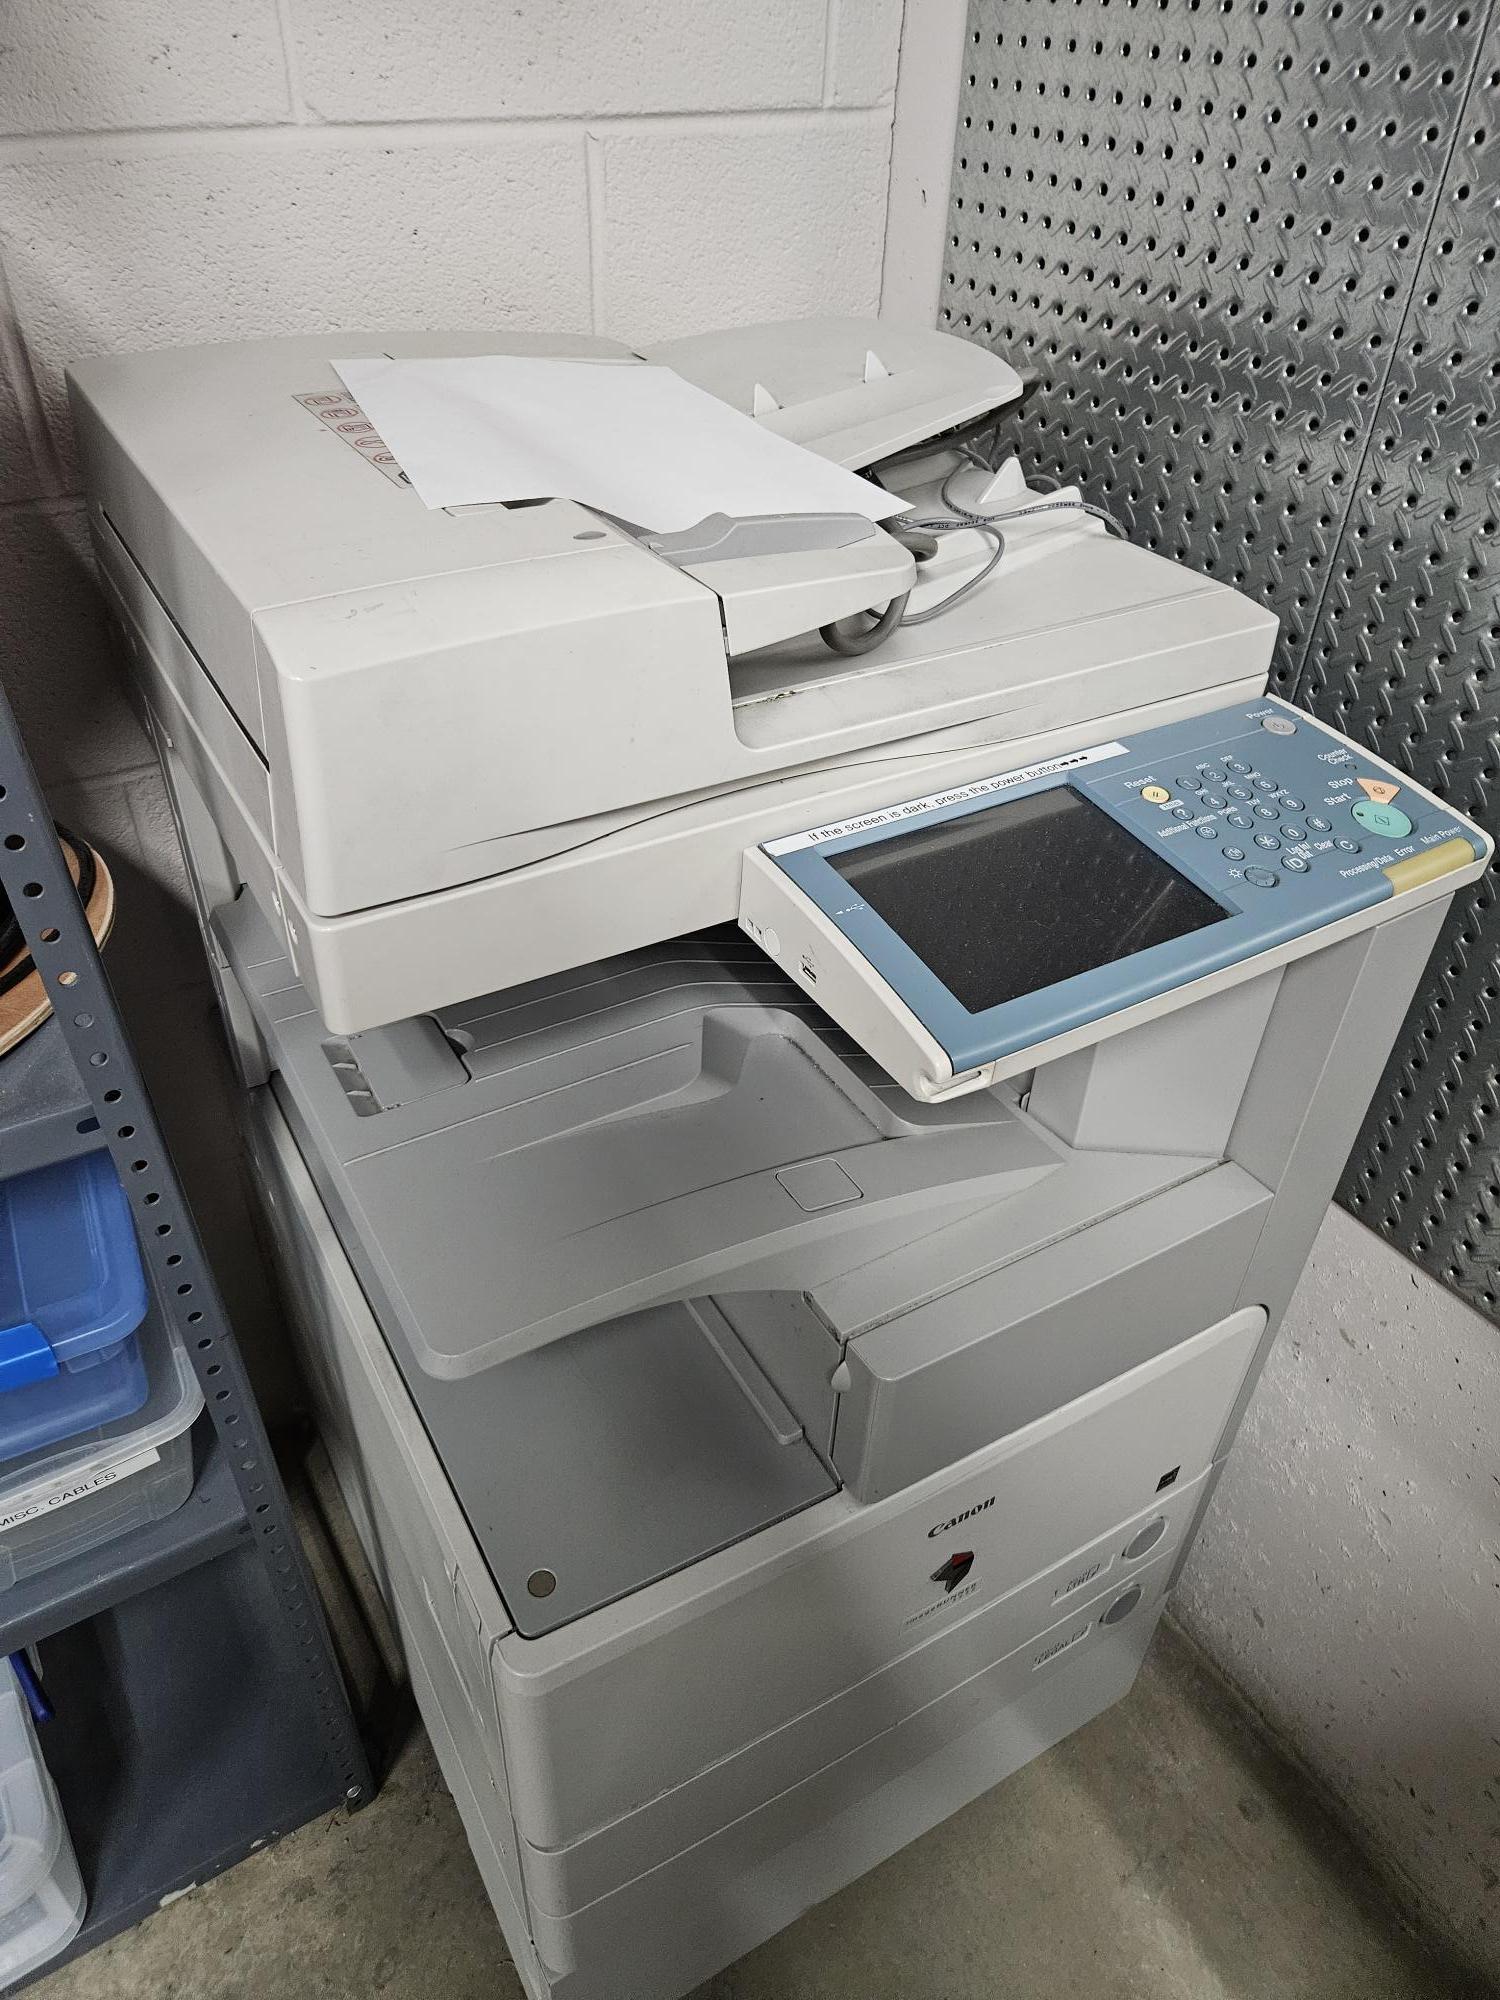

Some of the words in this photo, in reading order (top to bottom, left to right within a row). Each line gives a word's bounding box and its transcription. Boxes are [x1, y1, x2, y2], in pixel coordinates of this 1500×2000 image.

[1246, 708, 1274, 719] Power
[1234, 763, 1245, 771] 3
[1209, 771, 1221, 780] 2
[1123, 775, 1157, 789] Reset
[1260, 781, 1272, 790] 6
[1328, 777, 1354, 789] Stop
[1234, 789, 1246, 797] 5
[1323, 792, 1351, 805] Start
[808, 832, 820, 842] If
[820, 826, 843, 838] the
[845, 814, 888, 832] screen
[889, 811, 901, 819] is
[935, 789, 969, 806] press
[968, 784, 990, 795] the
[991, 773, 1025, 790] power
[1025, 761, 1062, 777] button
[1210, 798, 1221, 806] 4
[1286, 799, 1298, 808] 9
[1260, 808, 1273, 817] 8
[1233, 817, 1245, 826] 7
[1420, 832, 1441, 845] Main
[1437, 826, 1462, 840] Power
[1340, 840, 1353, 850] C
[1285, 857, 1305, 870] ID
[1339, 854, 1395, 879] Processing/Data
[1393, 845, 1416, 857] Error
[48, 1471, 117, 1506] CABLES
[927, 1495, 996, 1538] Canon
